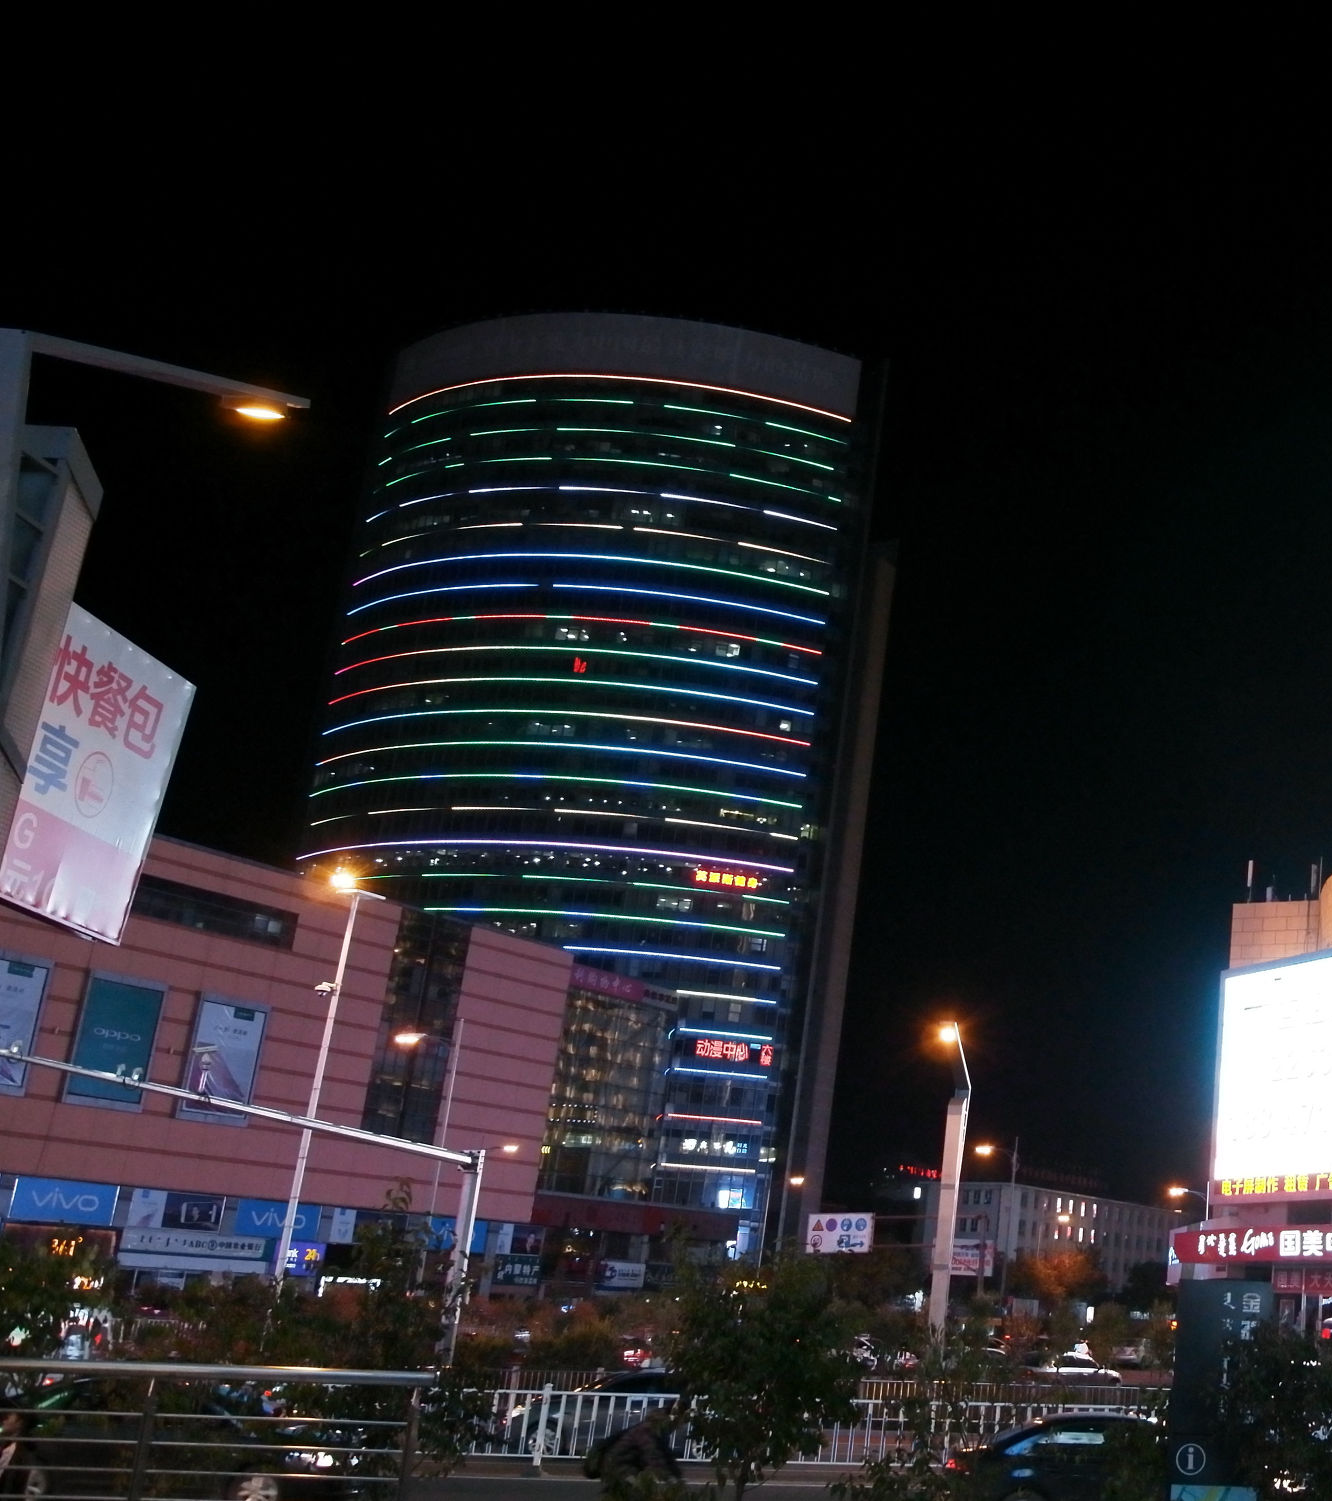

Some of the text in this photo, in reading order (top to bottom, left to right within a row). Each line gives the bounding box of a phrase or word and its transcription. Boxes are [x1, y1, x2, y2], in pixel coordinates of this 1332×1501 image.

[48, 634, 165, 761] 快餐包
[27, 720, 80, 796] 享
[696, 1039, 750, 1062] 动漫中心
[31, 1187, 100, 1212] vivo
